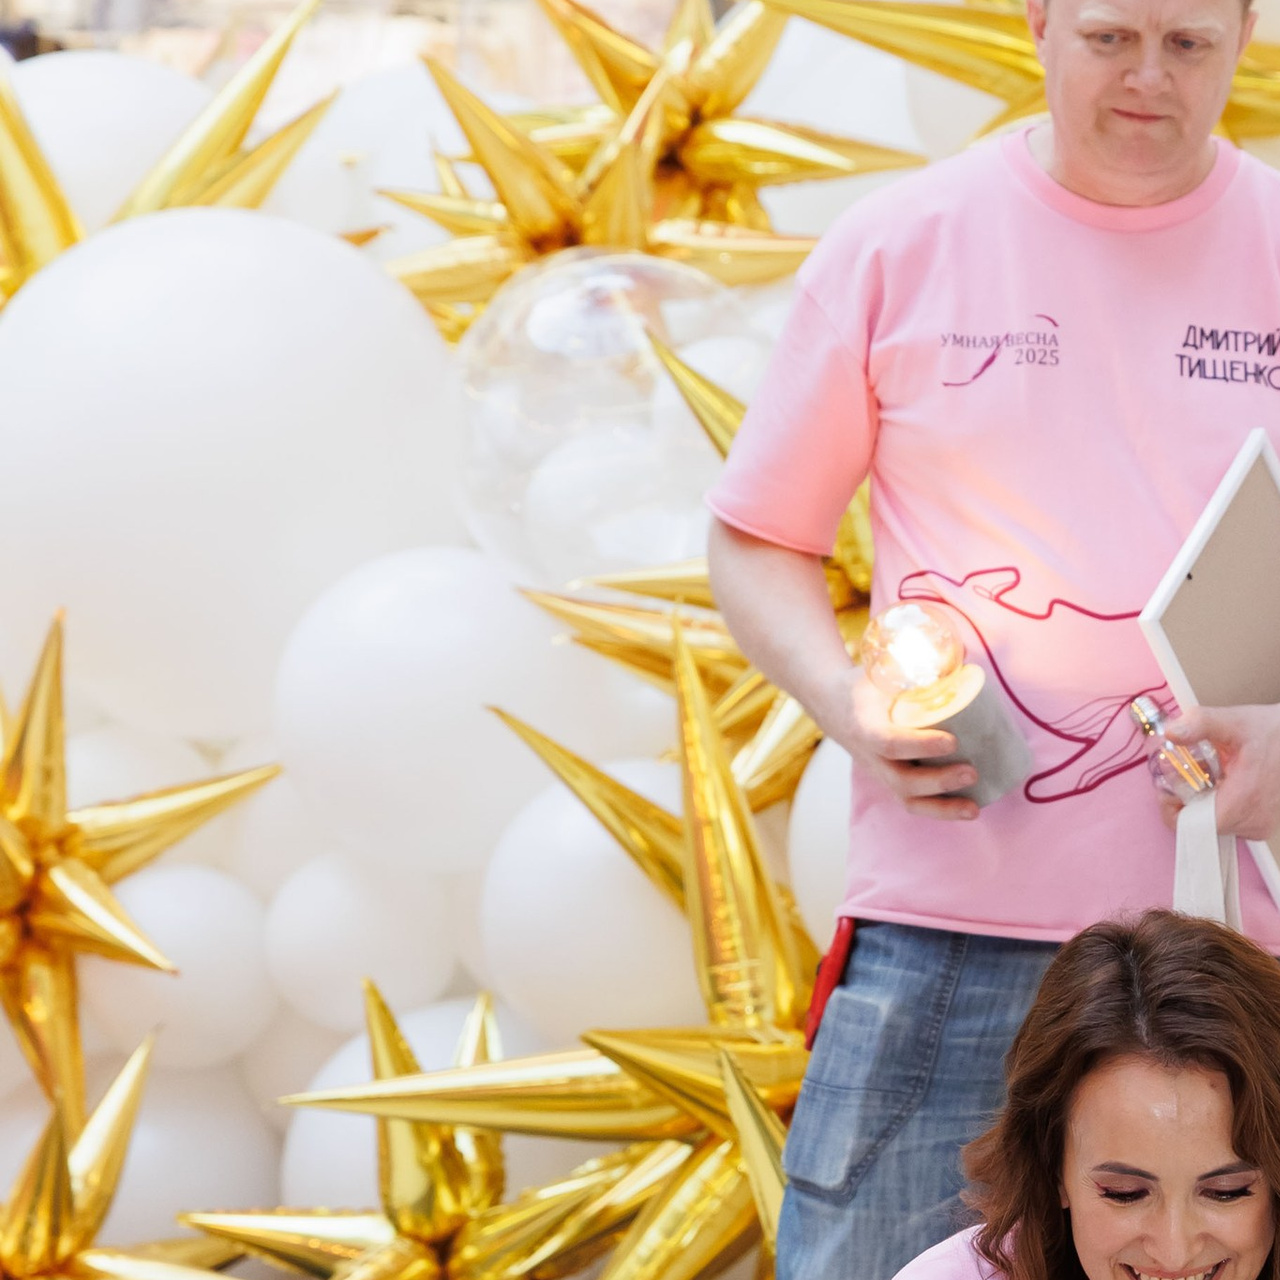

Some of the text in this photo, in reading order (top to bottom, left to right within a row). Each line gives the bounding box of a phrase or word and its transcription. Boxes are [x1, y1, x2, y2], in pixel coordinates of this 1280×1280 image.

[940, 332, 1059, 349] УМНАЯ ВЕСНА
[1015, 348, 1059, 366] 2025
